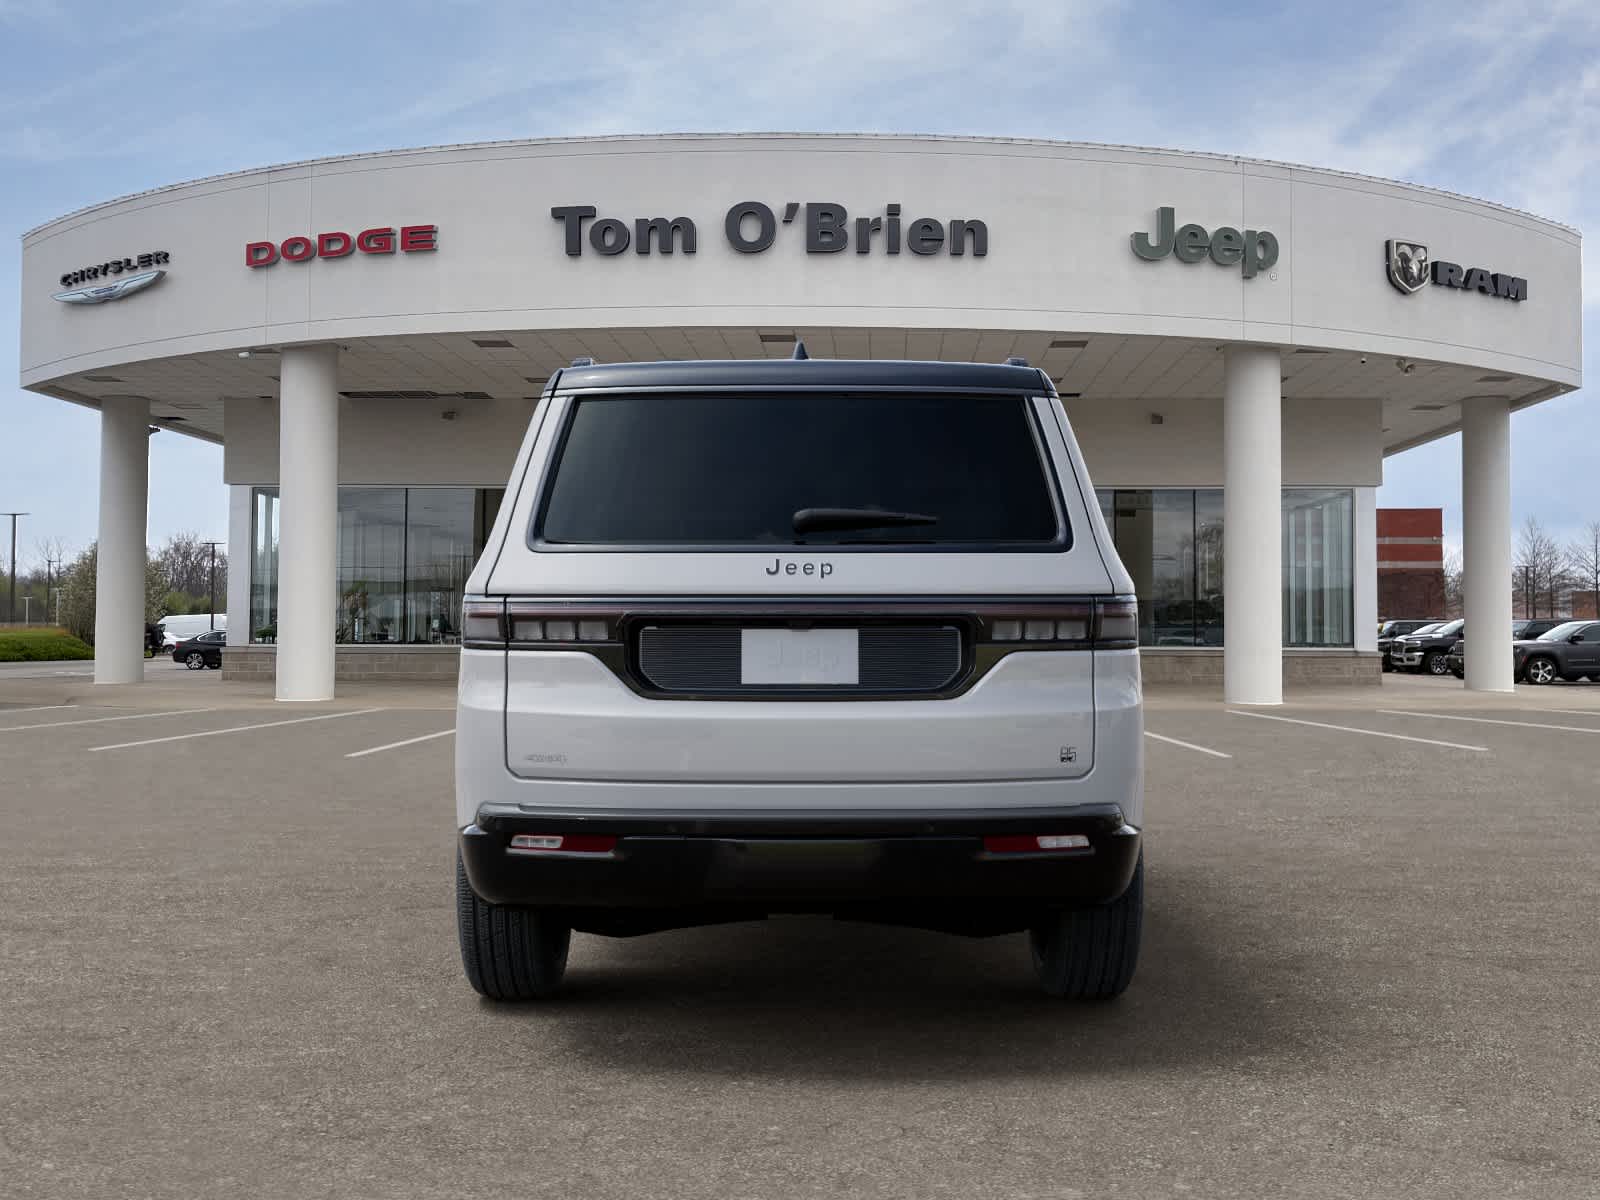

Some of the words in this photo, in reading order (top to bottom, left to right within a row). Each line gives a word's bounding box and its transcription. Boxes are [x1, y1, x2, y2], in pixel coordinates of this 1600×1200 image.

[246, 225, 438, 269] DODGE
[551, 205, 697, 257] Tom
[724, 201, 988, 257] O'Brien
[1130, 206, 1280, 279] Jeep
[60, 250, 170, 287] CHRYSLER
[1430, 260, 1528, 302] RAM
[765, 558, 833, 579] Jeep
